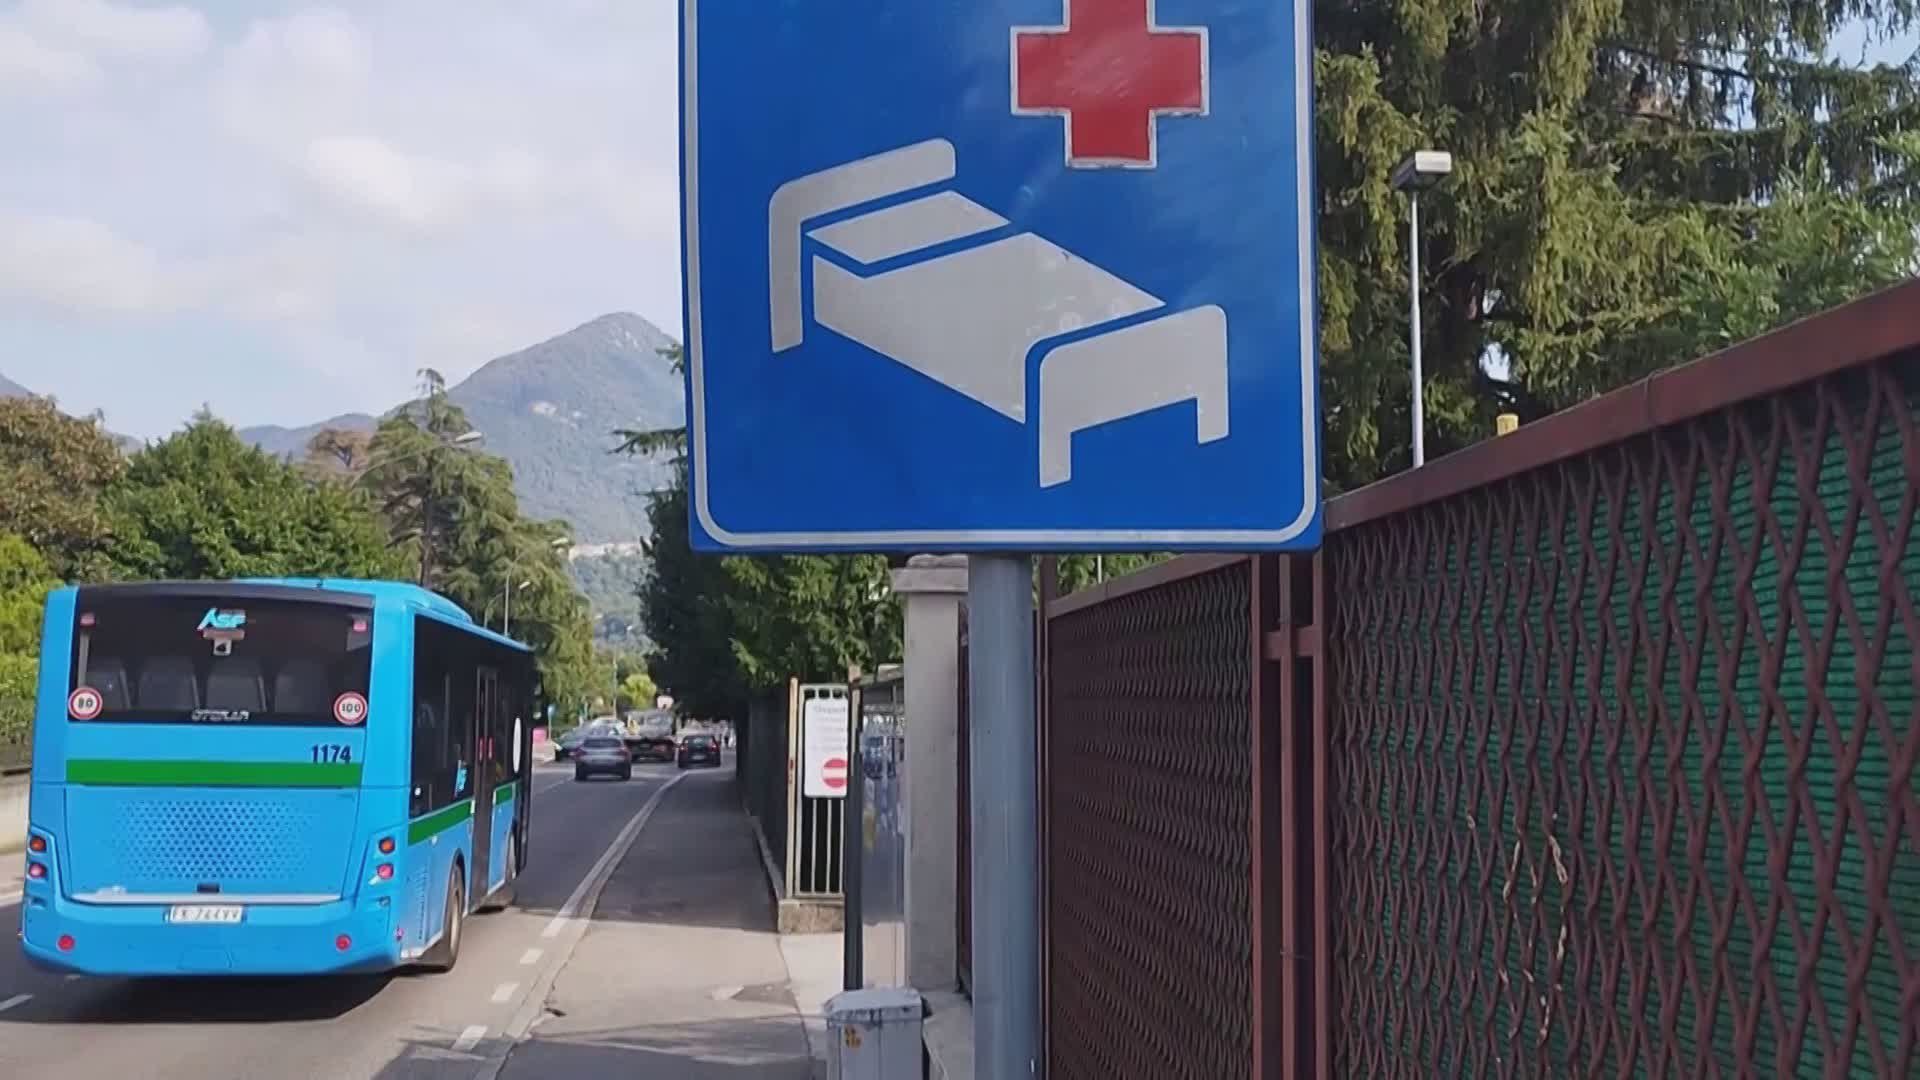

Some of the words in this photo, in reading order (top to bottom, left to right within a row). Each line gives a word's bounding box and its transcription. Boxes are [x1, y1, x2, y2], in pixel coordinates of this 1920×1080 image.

[78, 696, 93, 709] 80
[341, 703, 361, 713] 100
[311, 743, 352, 765] 1174
